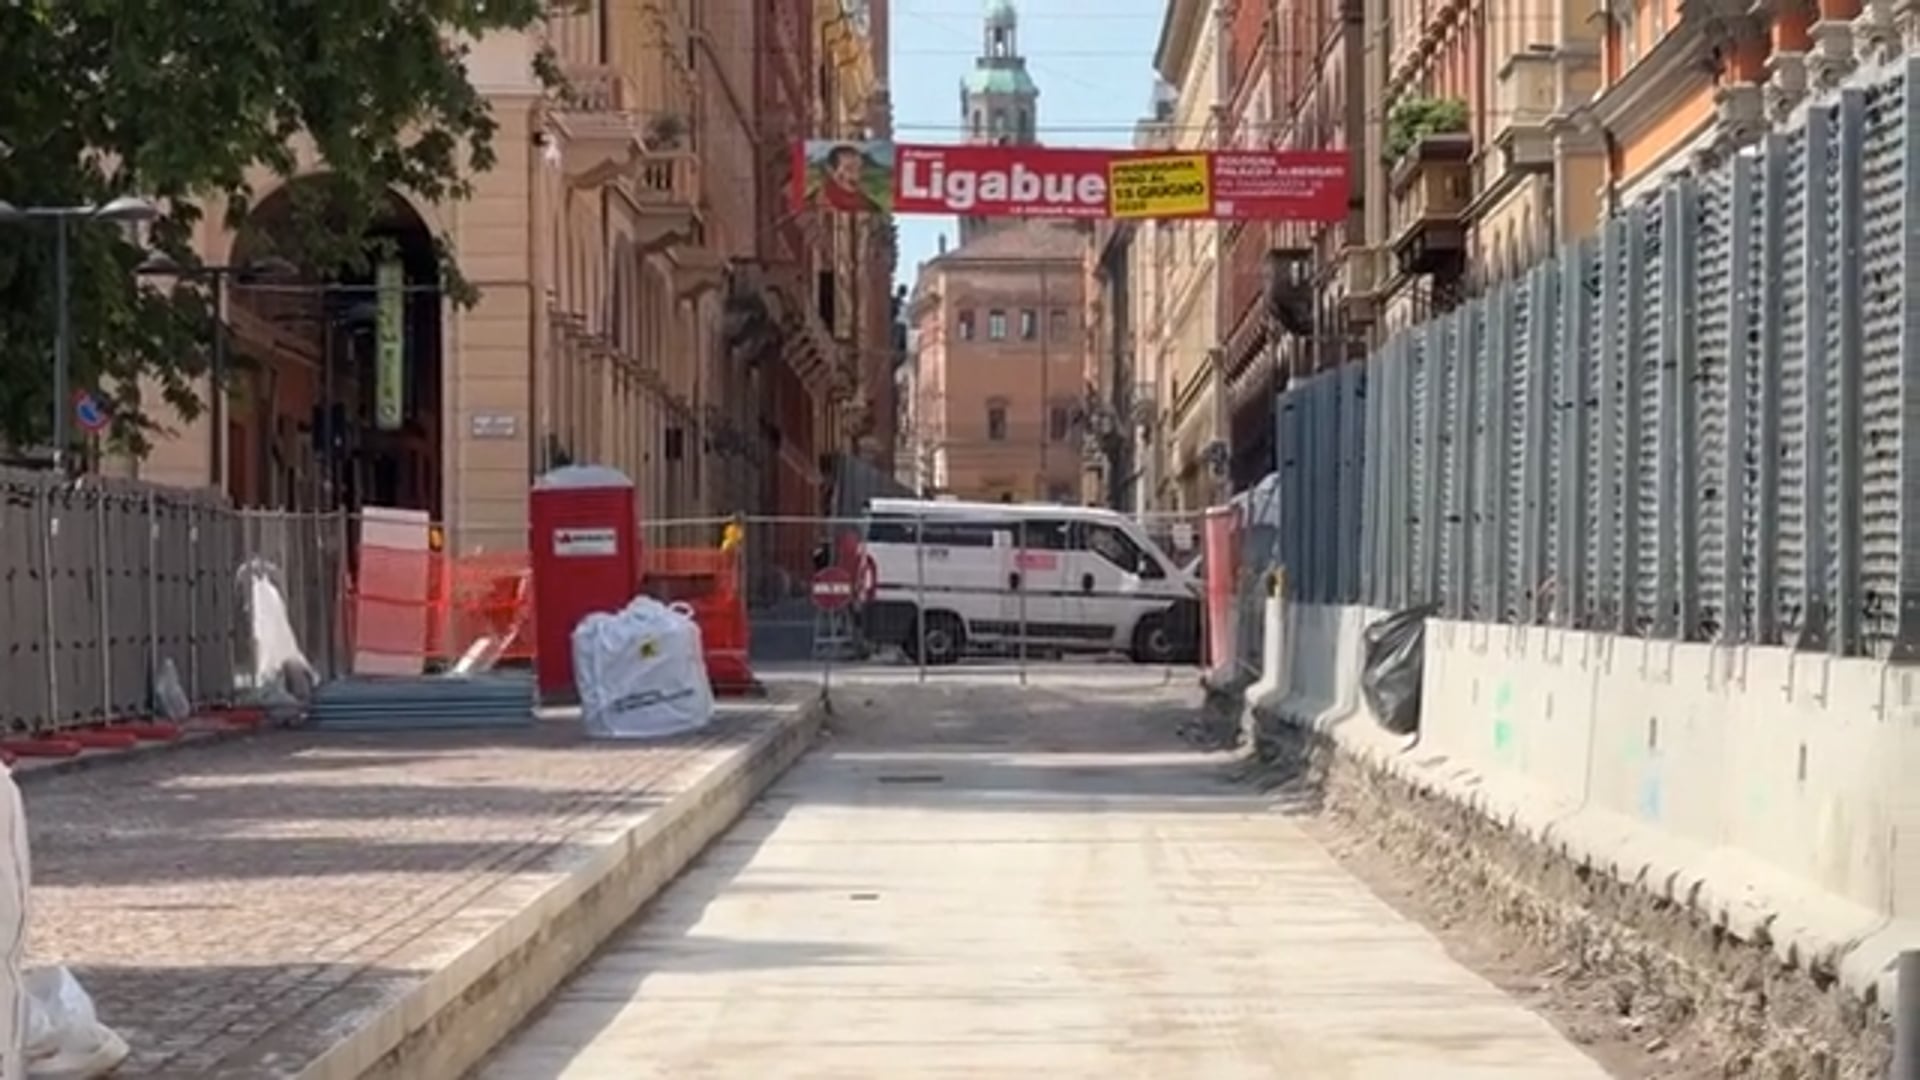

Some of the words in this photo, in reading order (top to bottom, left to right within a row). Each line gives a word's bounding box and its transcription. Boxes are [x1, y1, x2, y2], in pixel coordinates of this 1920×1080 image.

[1215, 156, 1277, 166] BOLOGNA
[901, 160, 1106, 209] Ligabue
[1136, 181, 1204, 199] GIUGNO
